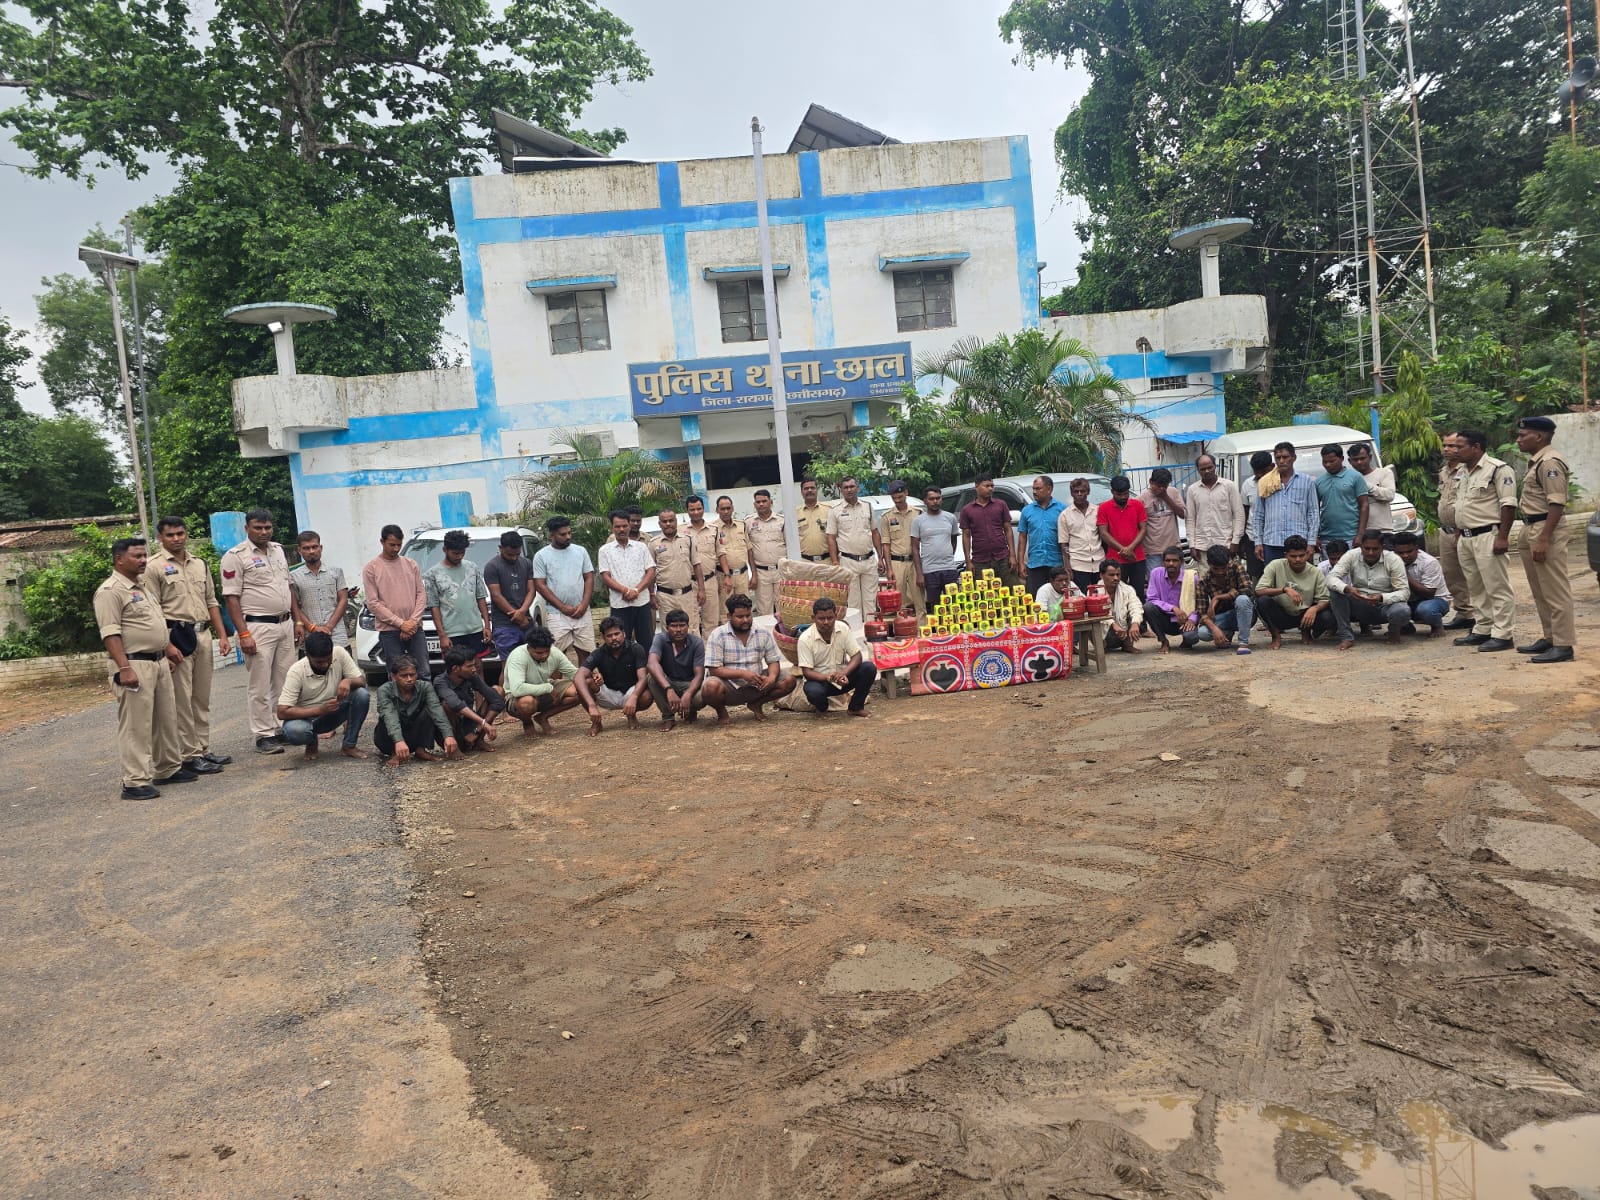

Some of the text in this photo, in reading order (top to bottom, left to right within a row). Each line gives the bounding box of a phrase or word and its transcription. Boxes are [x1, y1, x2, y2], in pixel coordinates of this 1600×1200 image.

[634, 353, 905, 405] पुलिस थना-छाल
[786, 387, 847, 400] छत्तीसगढ़)
